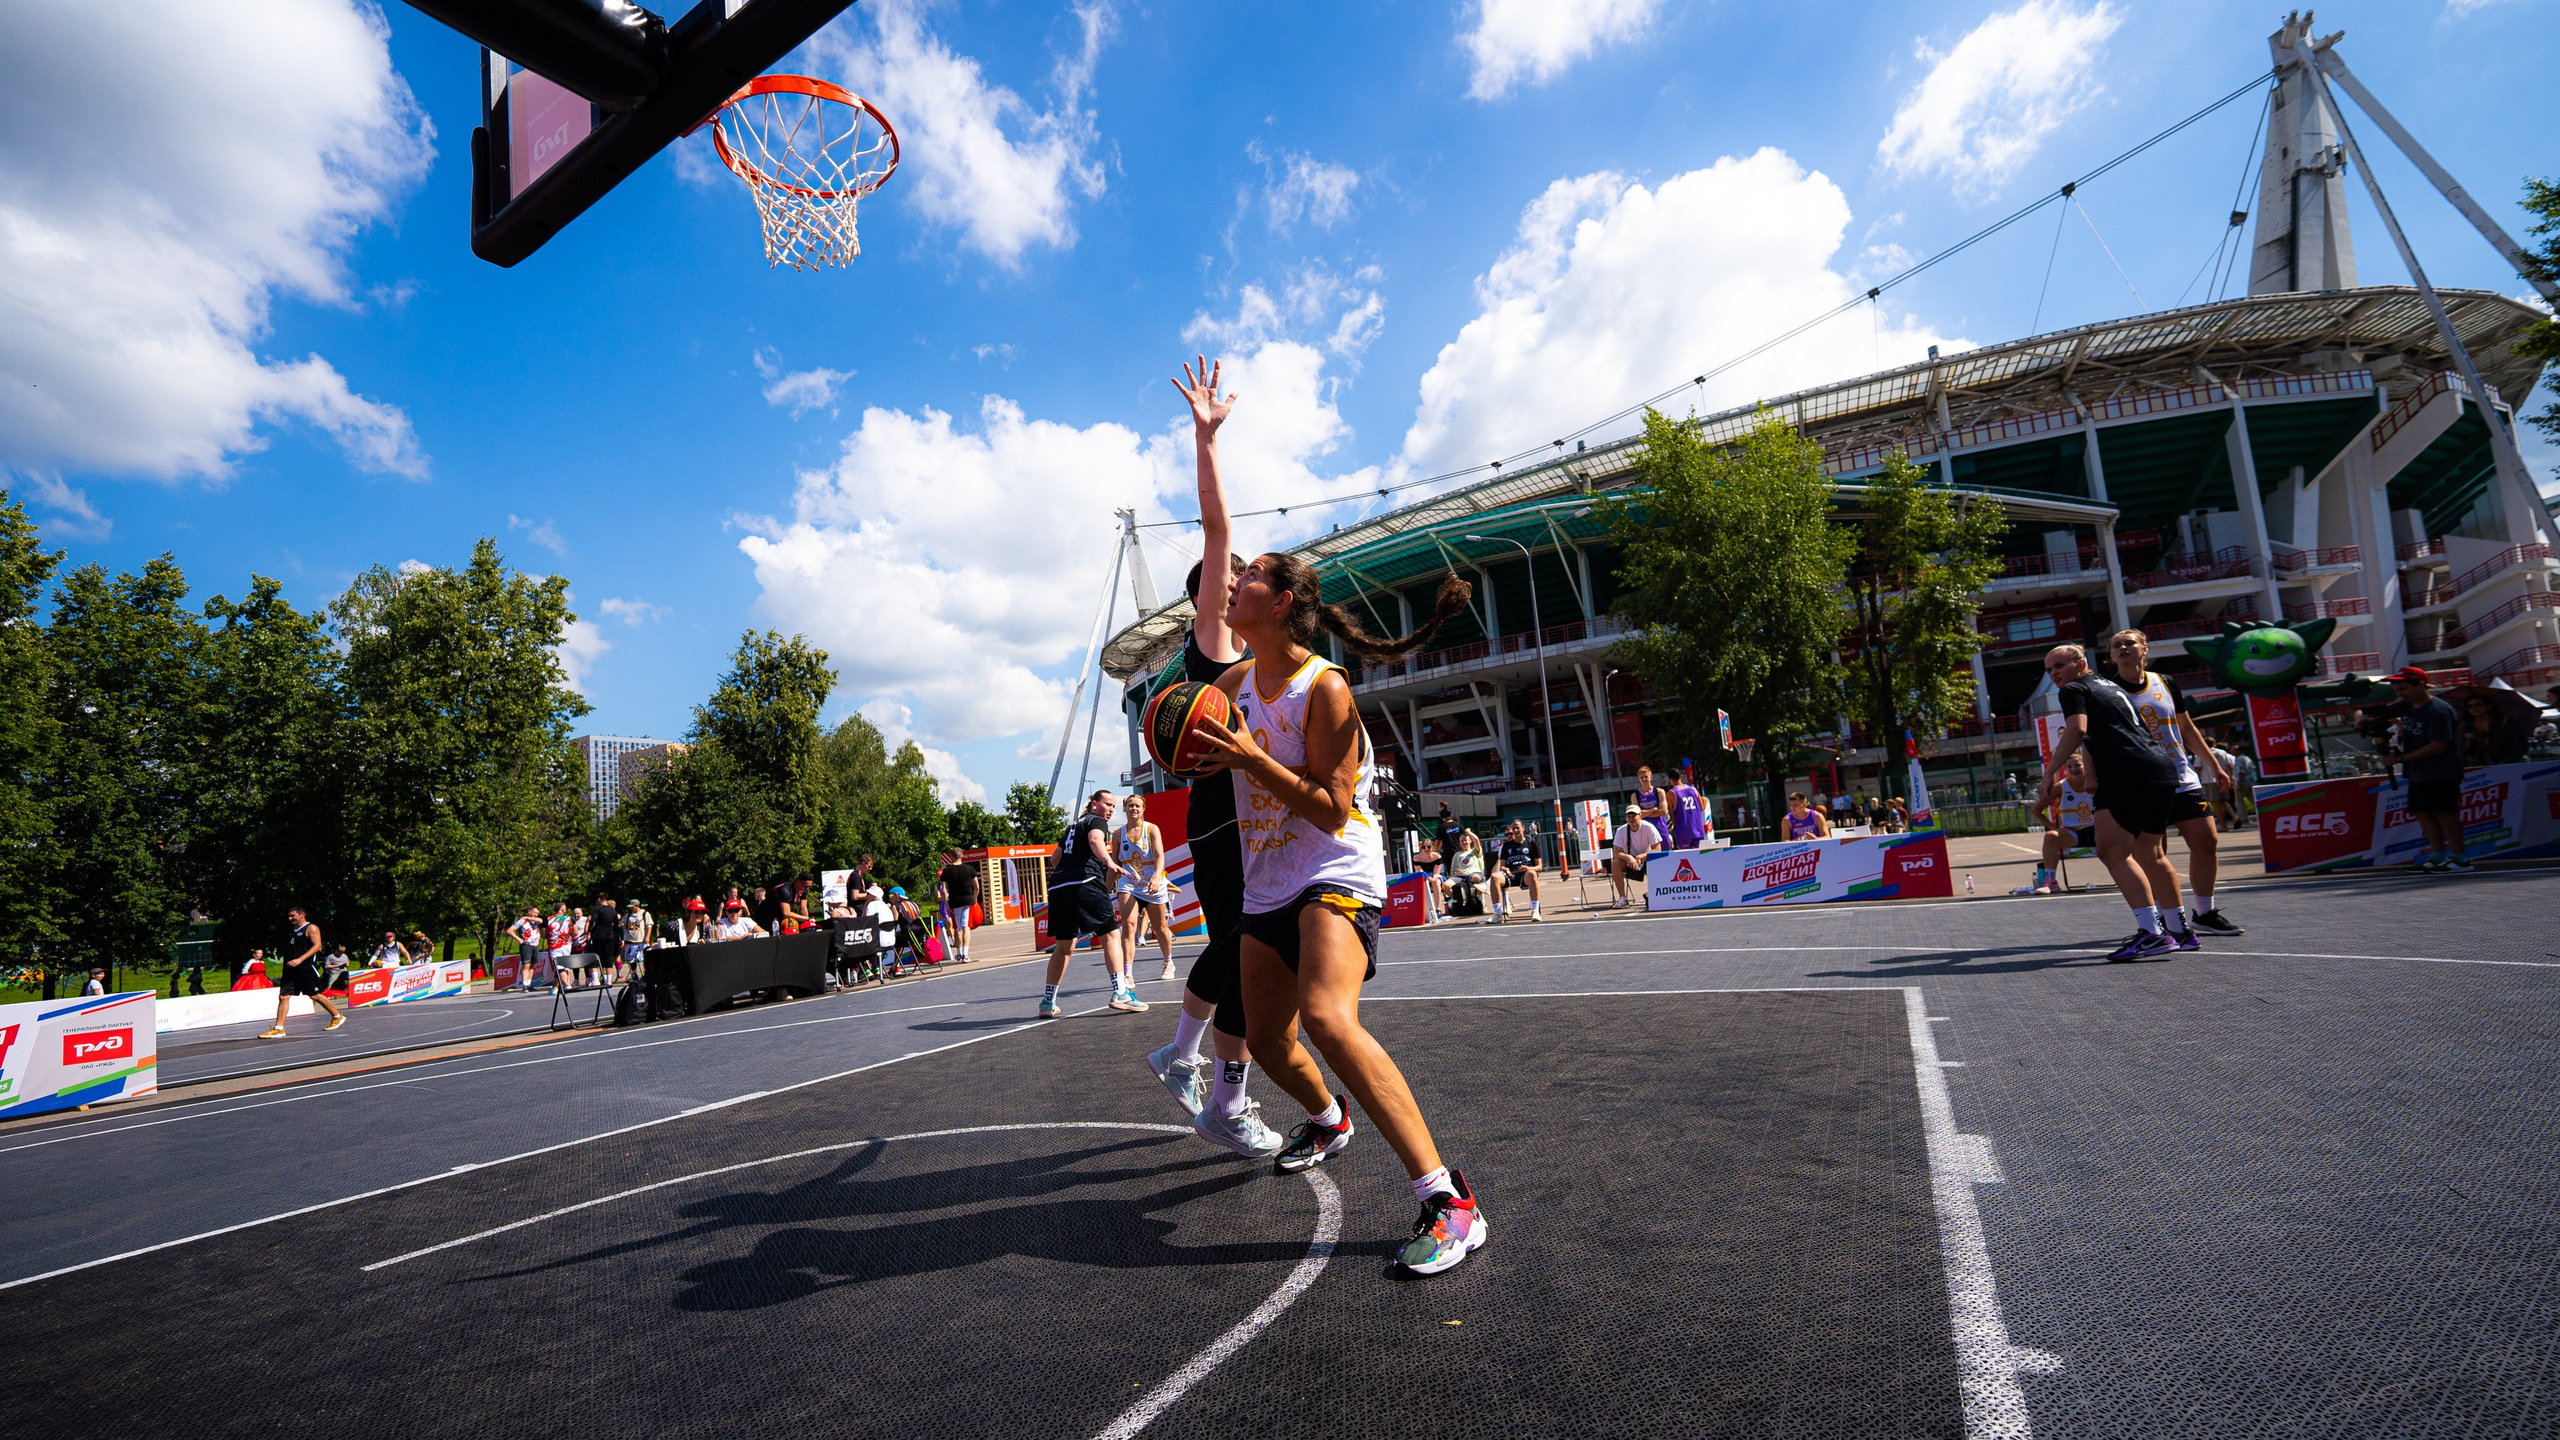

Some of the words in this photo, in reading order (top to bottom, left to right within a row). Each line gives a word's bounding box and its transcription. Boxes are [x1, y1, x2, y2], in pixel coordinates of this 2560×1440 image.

[2153, 693, 2163, 701] 7
[2116, 690, 2140, 726] 1
[1682, 796, 1696, 810] 22
[2198, 802, 2208, 811] 7
[2275, 812, 2350, 835] АСБ
[1746, 852, 1815, 880] ДОСТИГАЯ
[1769, 863, 1814, 885] ЦЕЛИ!
[1655, 884, 1718, 897] ЛОКОМОТИВ
[844, 928, 873, 943] АСБ
[354, 981, 382, 992] АСБ
[63, 1024, 107, 1034] ГЕНЕРАЛЬНЫЙ
[107, 1021, 134, 1029] ПАРТНЕР
